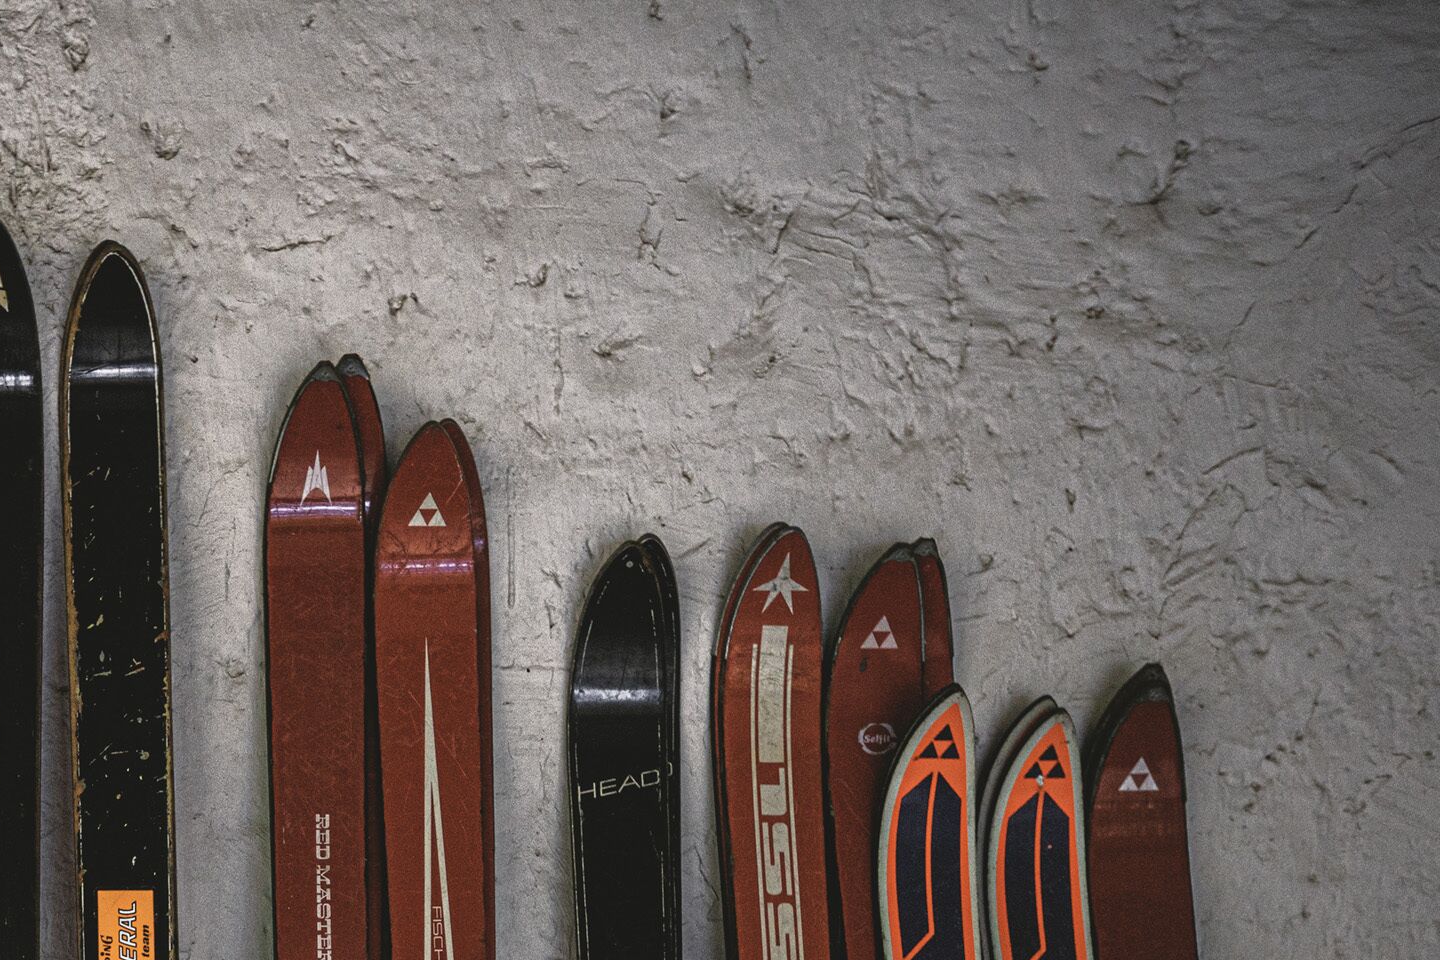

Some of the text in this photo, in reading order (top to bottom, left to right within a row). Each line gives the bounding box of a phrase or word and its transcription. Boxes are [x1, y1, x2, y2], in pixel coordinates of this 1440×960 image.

[577, 768, 660, 799] HEAD
[315, 813, 330, 860] RED
[141, 925, 150, 957] team
